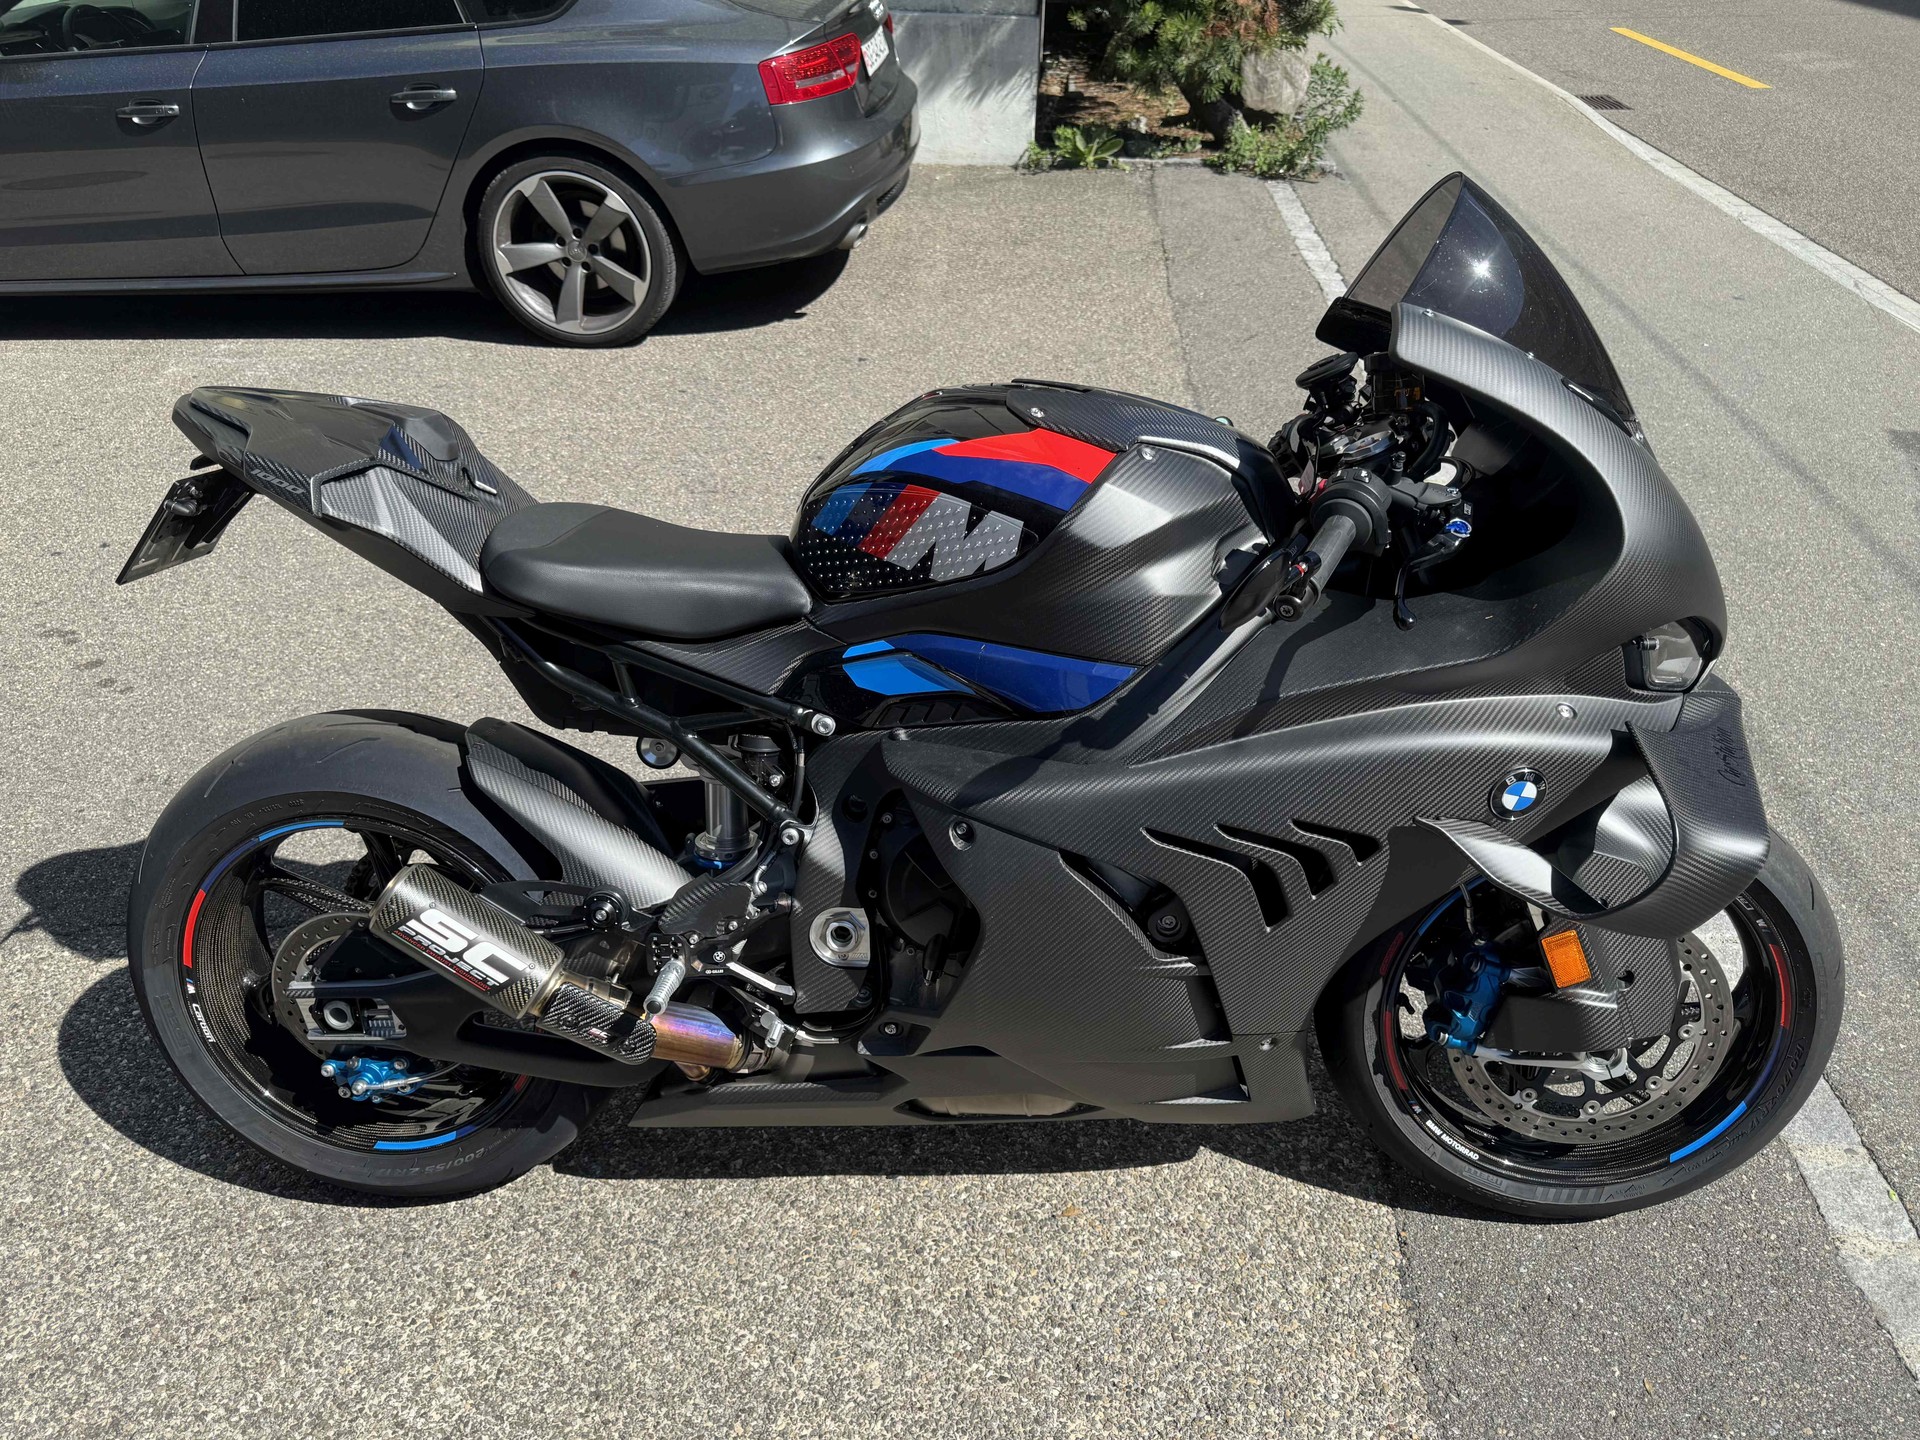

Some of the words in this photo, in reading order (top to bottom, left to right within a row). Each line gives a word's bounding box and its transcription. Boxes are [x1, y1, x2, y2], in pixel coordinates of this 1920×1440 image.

[251, 469, 305, 494] 1000
[885, 493, 1024, 582] M
[1505, 771, 1547, 791] BMW
[393, 930, 426, 951] ADVANCED
[425, 949, 452, 968] EXHAUST
[452, 965, 491, 990] TECHNOLOGY
[398, 925, 500, 987] PROJECT
[405, 908, 529, 984] SC
[192, 1003, 216, 1043] Carbon
[1425, 1119, 1442, 1136] BMW
[1441, 1133, 1480, 1161] MOTORRAD
